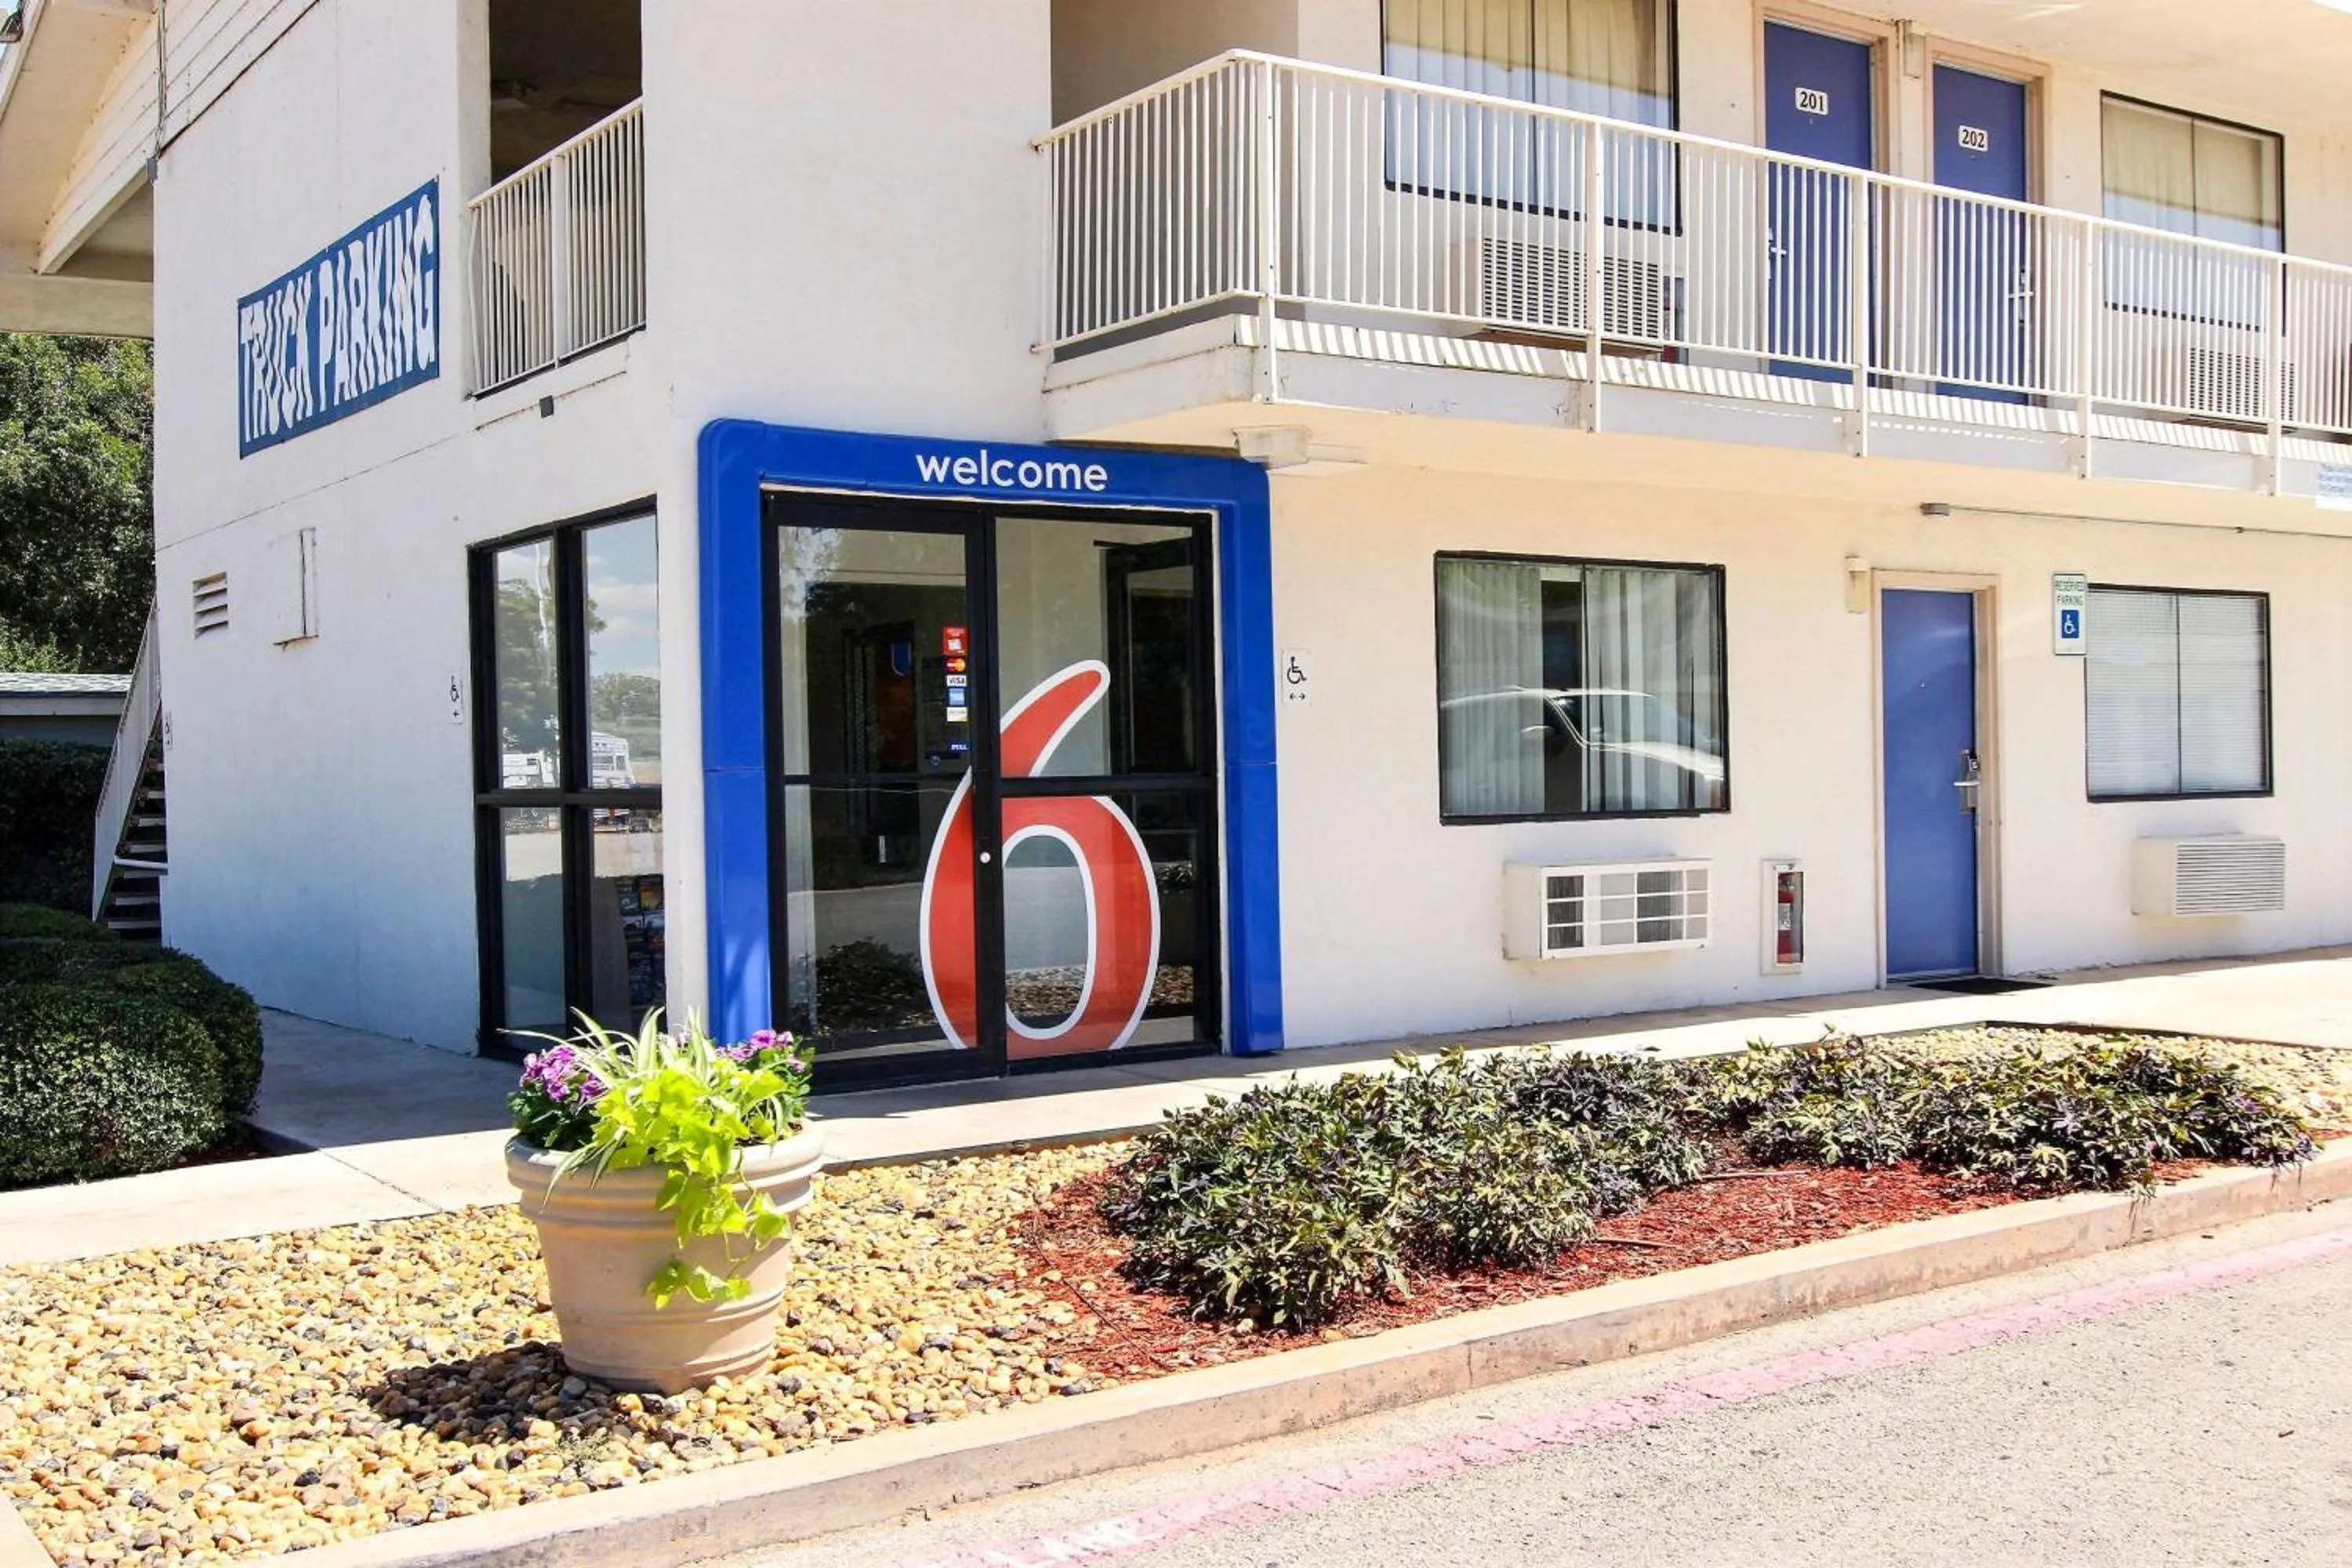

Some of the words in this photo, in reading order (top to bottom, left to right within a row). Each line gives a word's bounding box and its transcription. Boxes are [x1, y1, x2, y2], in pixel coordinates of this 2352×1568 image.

[1799, 90, 1824, 112] 201
[1962, 129, 1985, 148] 202
[239, 270, 313, 442] TRUCK
[318, 193, 435, 412] PARKING
[916, 449, 1109, 492] welcome
[2056, 595, 2083, 605] PARKING
